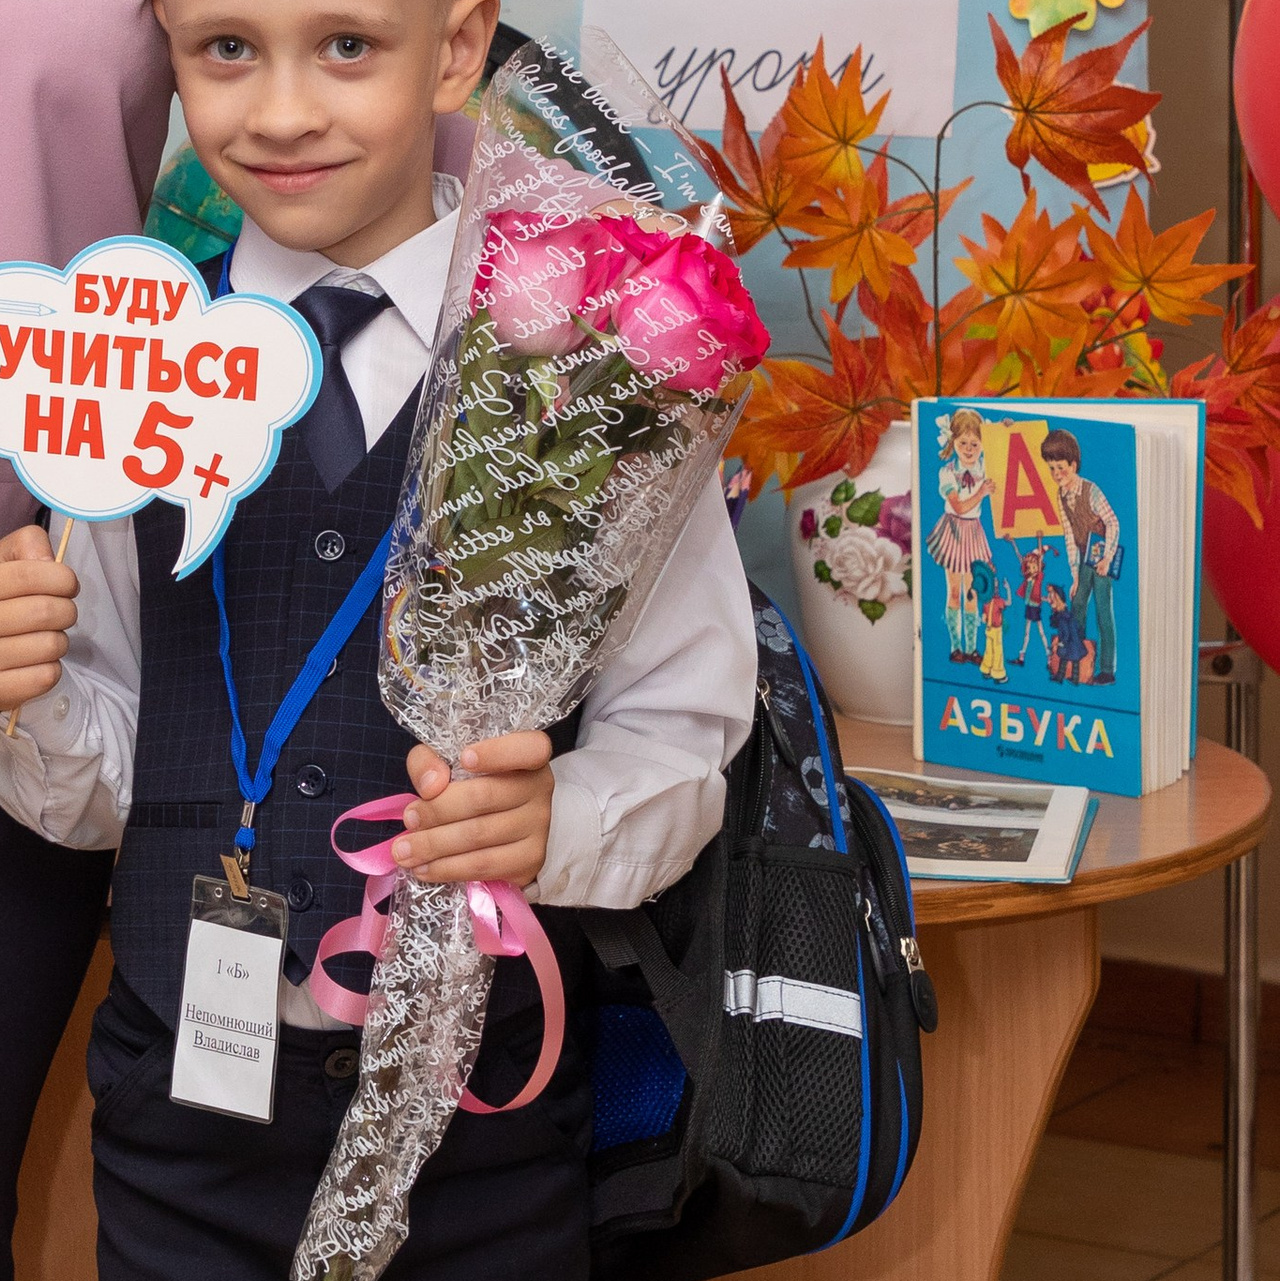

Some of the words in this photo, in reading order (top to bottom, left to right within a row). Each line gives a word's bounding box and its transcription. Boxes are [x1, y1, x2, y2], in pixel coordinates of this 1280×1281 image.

[581, 82, 634, 134] back
[73, 272, 189, 326] БУДУ
[22, 394, 106, 460] НА
[1001, 432, 1060, 529] А
[939, 694, 1115, 759] АЗБУКА
[226, 962, 250, 980] «Б»
[184, 1002, 274, 1039] Непомнющий
[193, 1029, 261, 1061] Владислав
